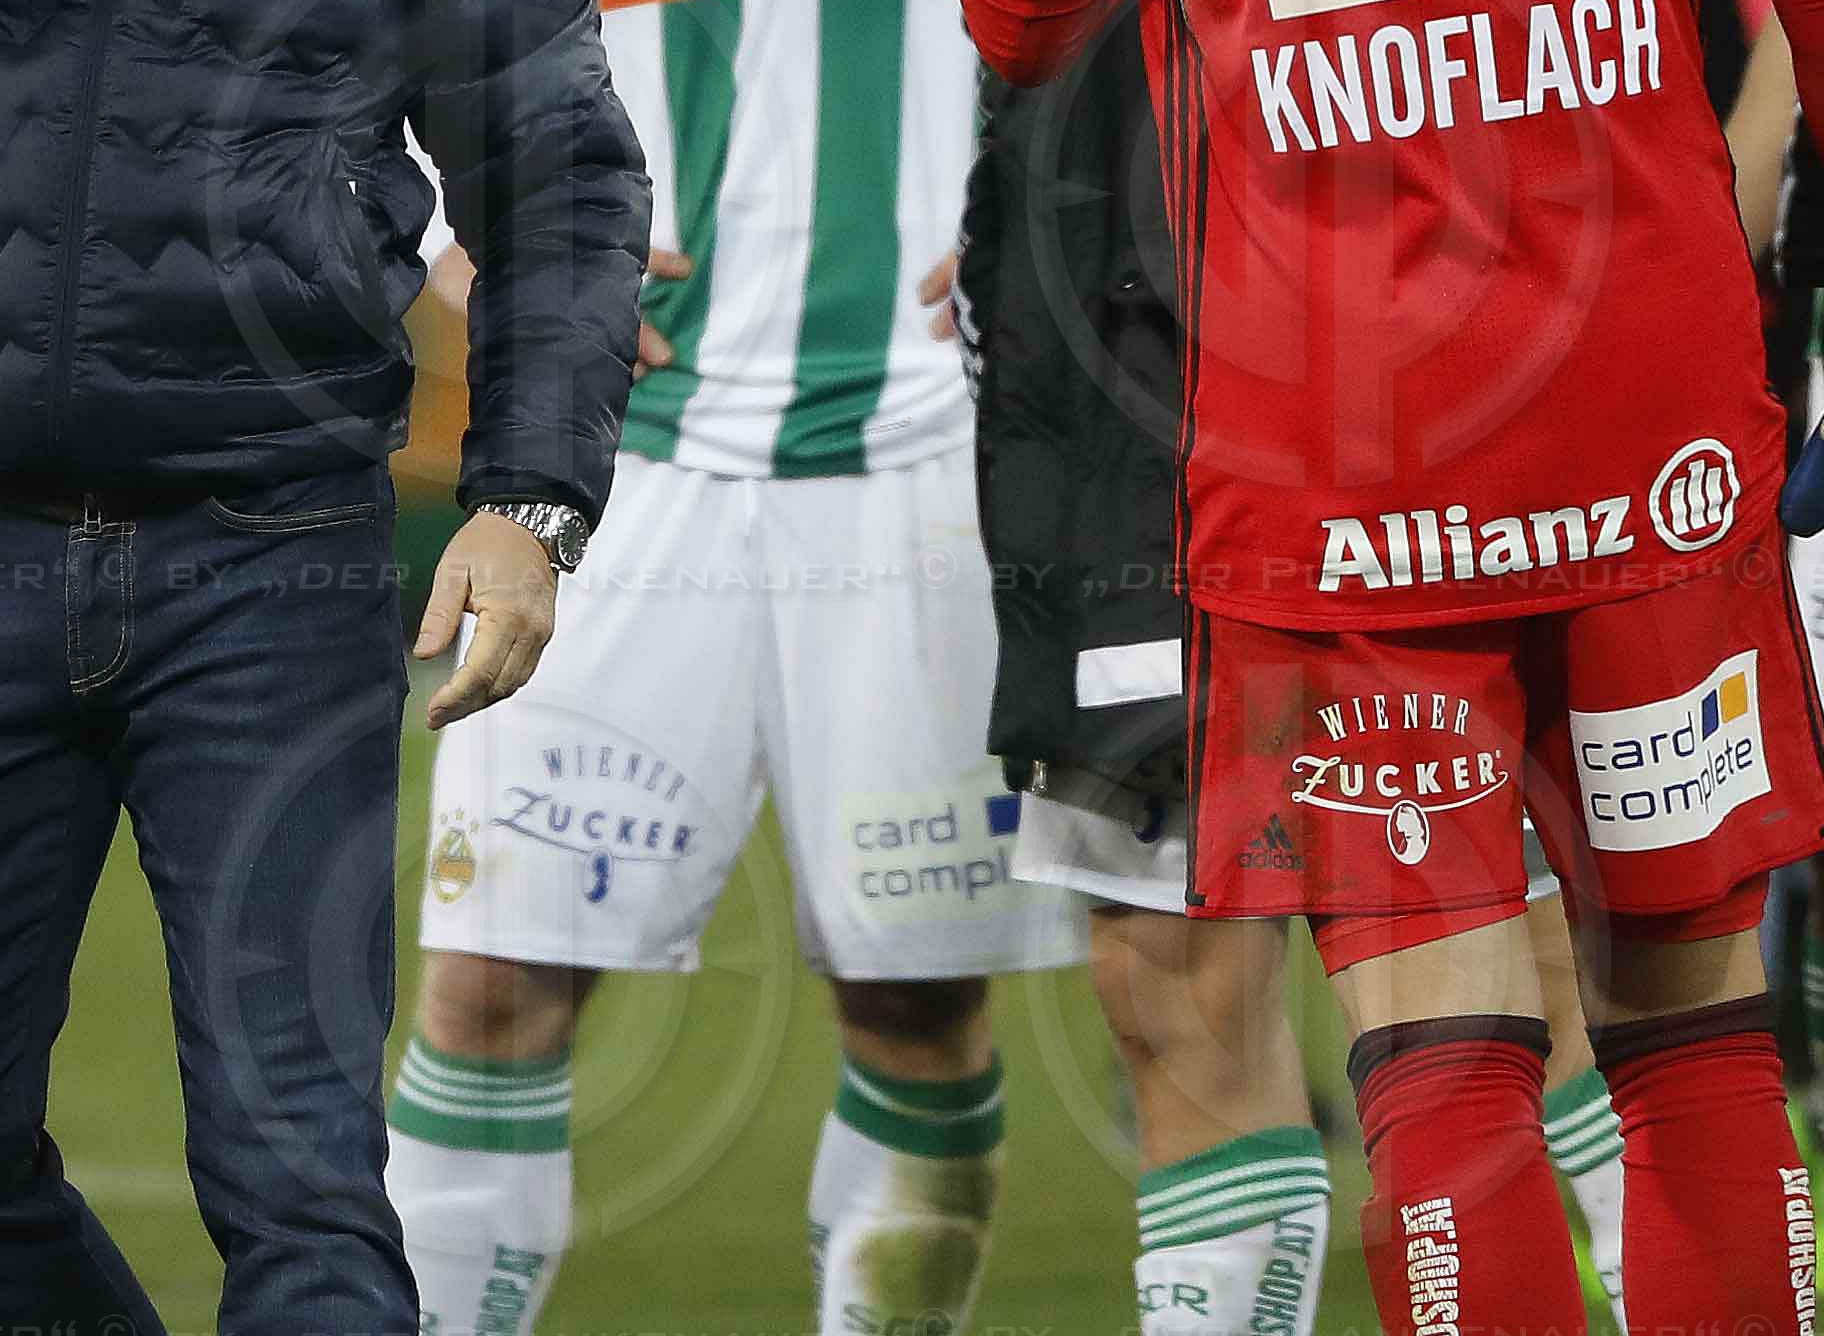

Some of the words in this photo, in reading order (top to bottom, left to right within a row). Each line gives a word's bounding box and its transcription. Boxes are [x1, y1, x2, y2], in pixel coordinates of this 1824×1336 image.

[1319, 493, 1635, 594] Allianz
[1316, 693, 1470, 743] WIENER
[1581, 711, 1696, 771] card
[1291, 752, 1500, 805] ZUCKER
[1590, 737, 1754, 822] complete
[855, 802, 958, 851] card
[861, 845, 1009, 903] compl
